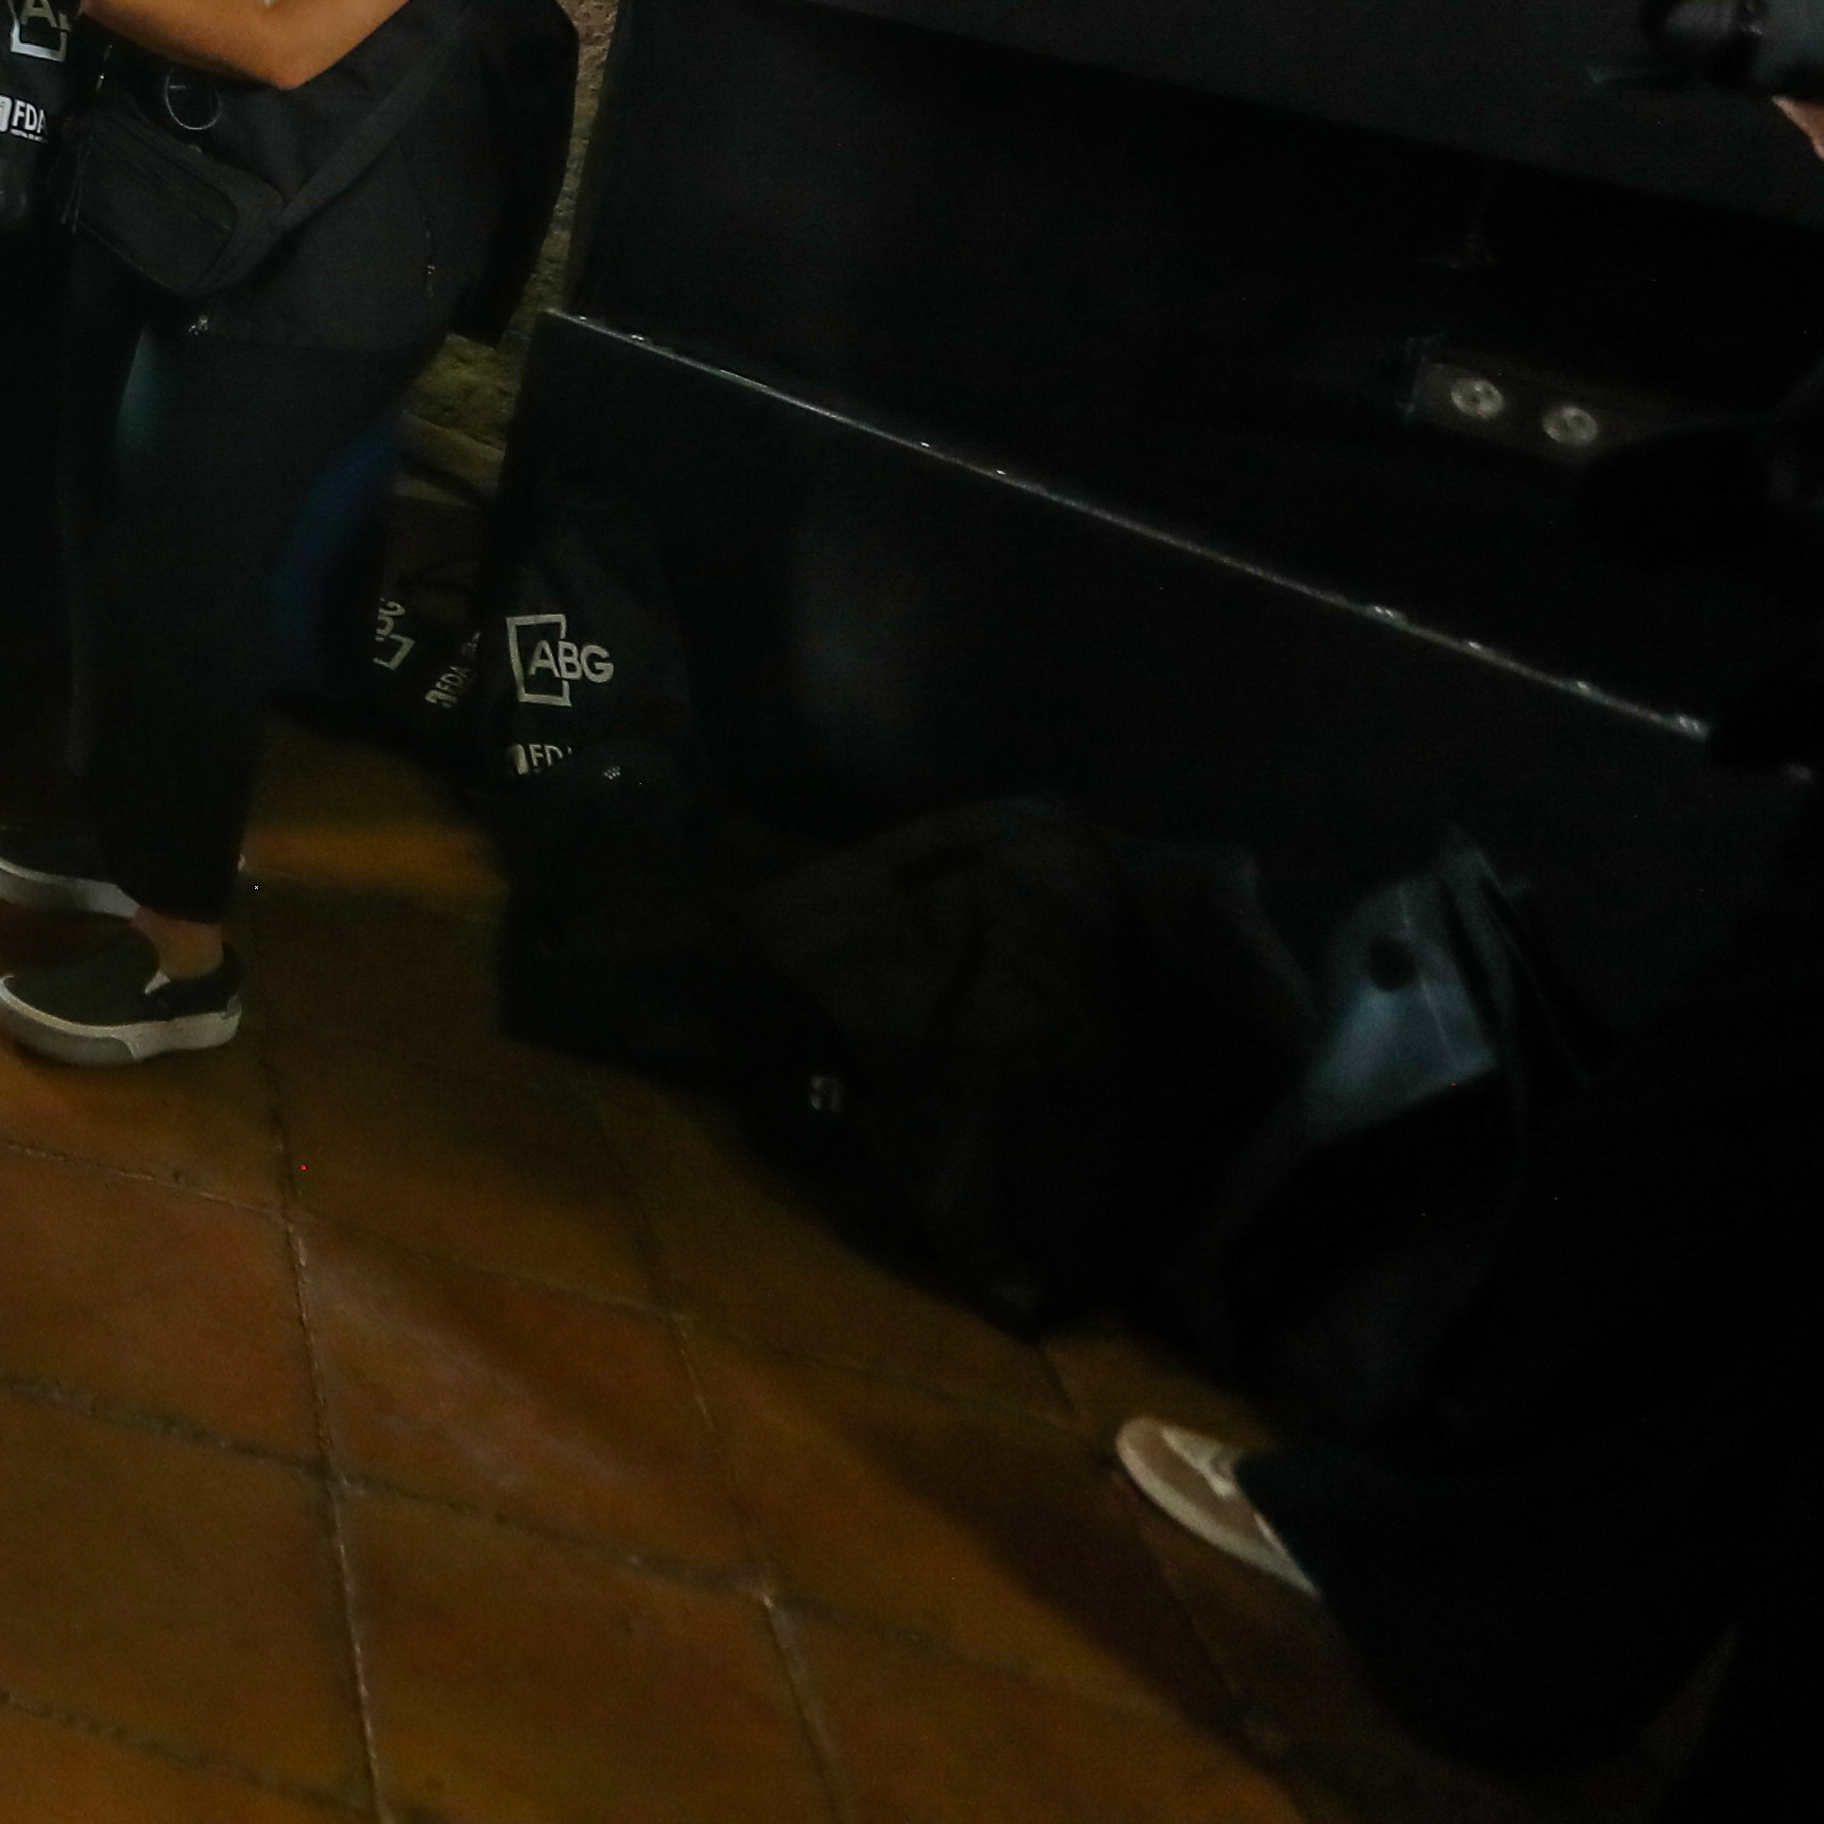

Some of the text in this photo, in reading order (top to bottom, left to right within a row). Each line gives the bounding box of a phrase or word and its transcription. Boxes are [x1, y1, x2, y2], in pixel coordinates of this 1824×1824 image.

[12, 99, 48, 134] FDA
[528, 640, 614, 683] ABG
[528, 743, 572, 767] FD
